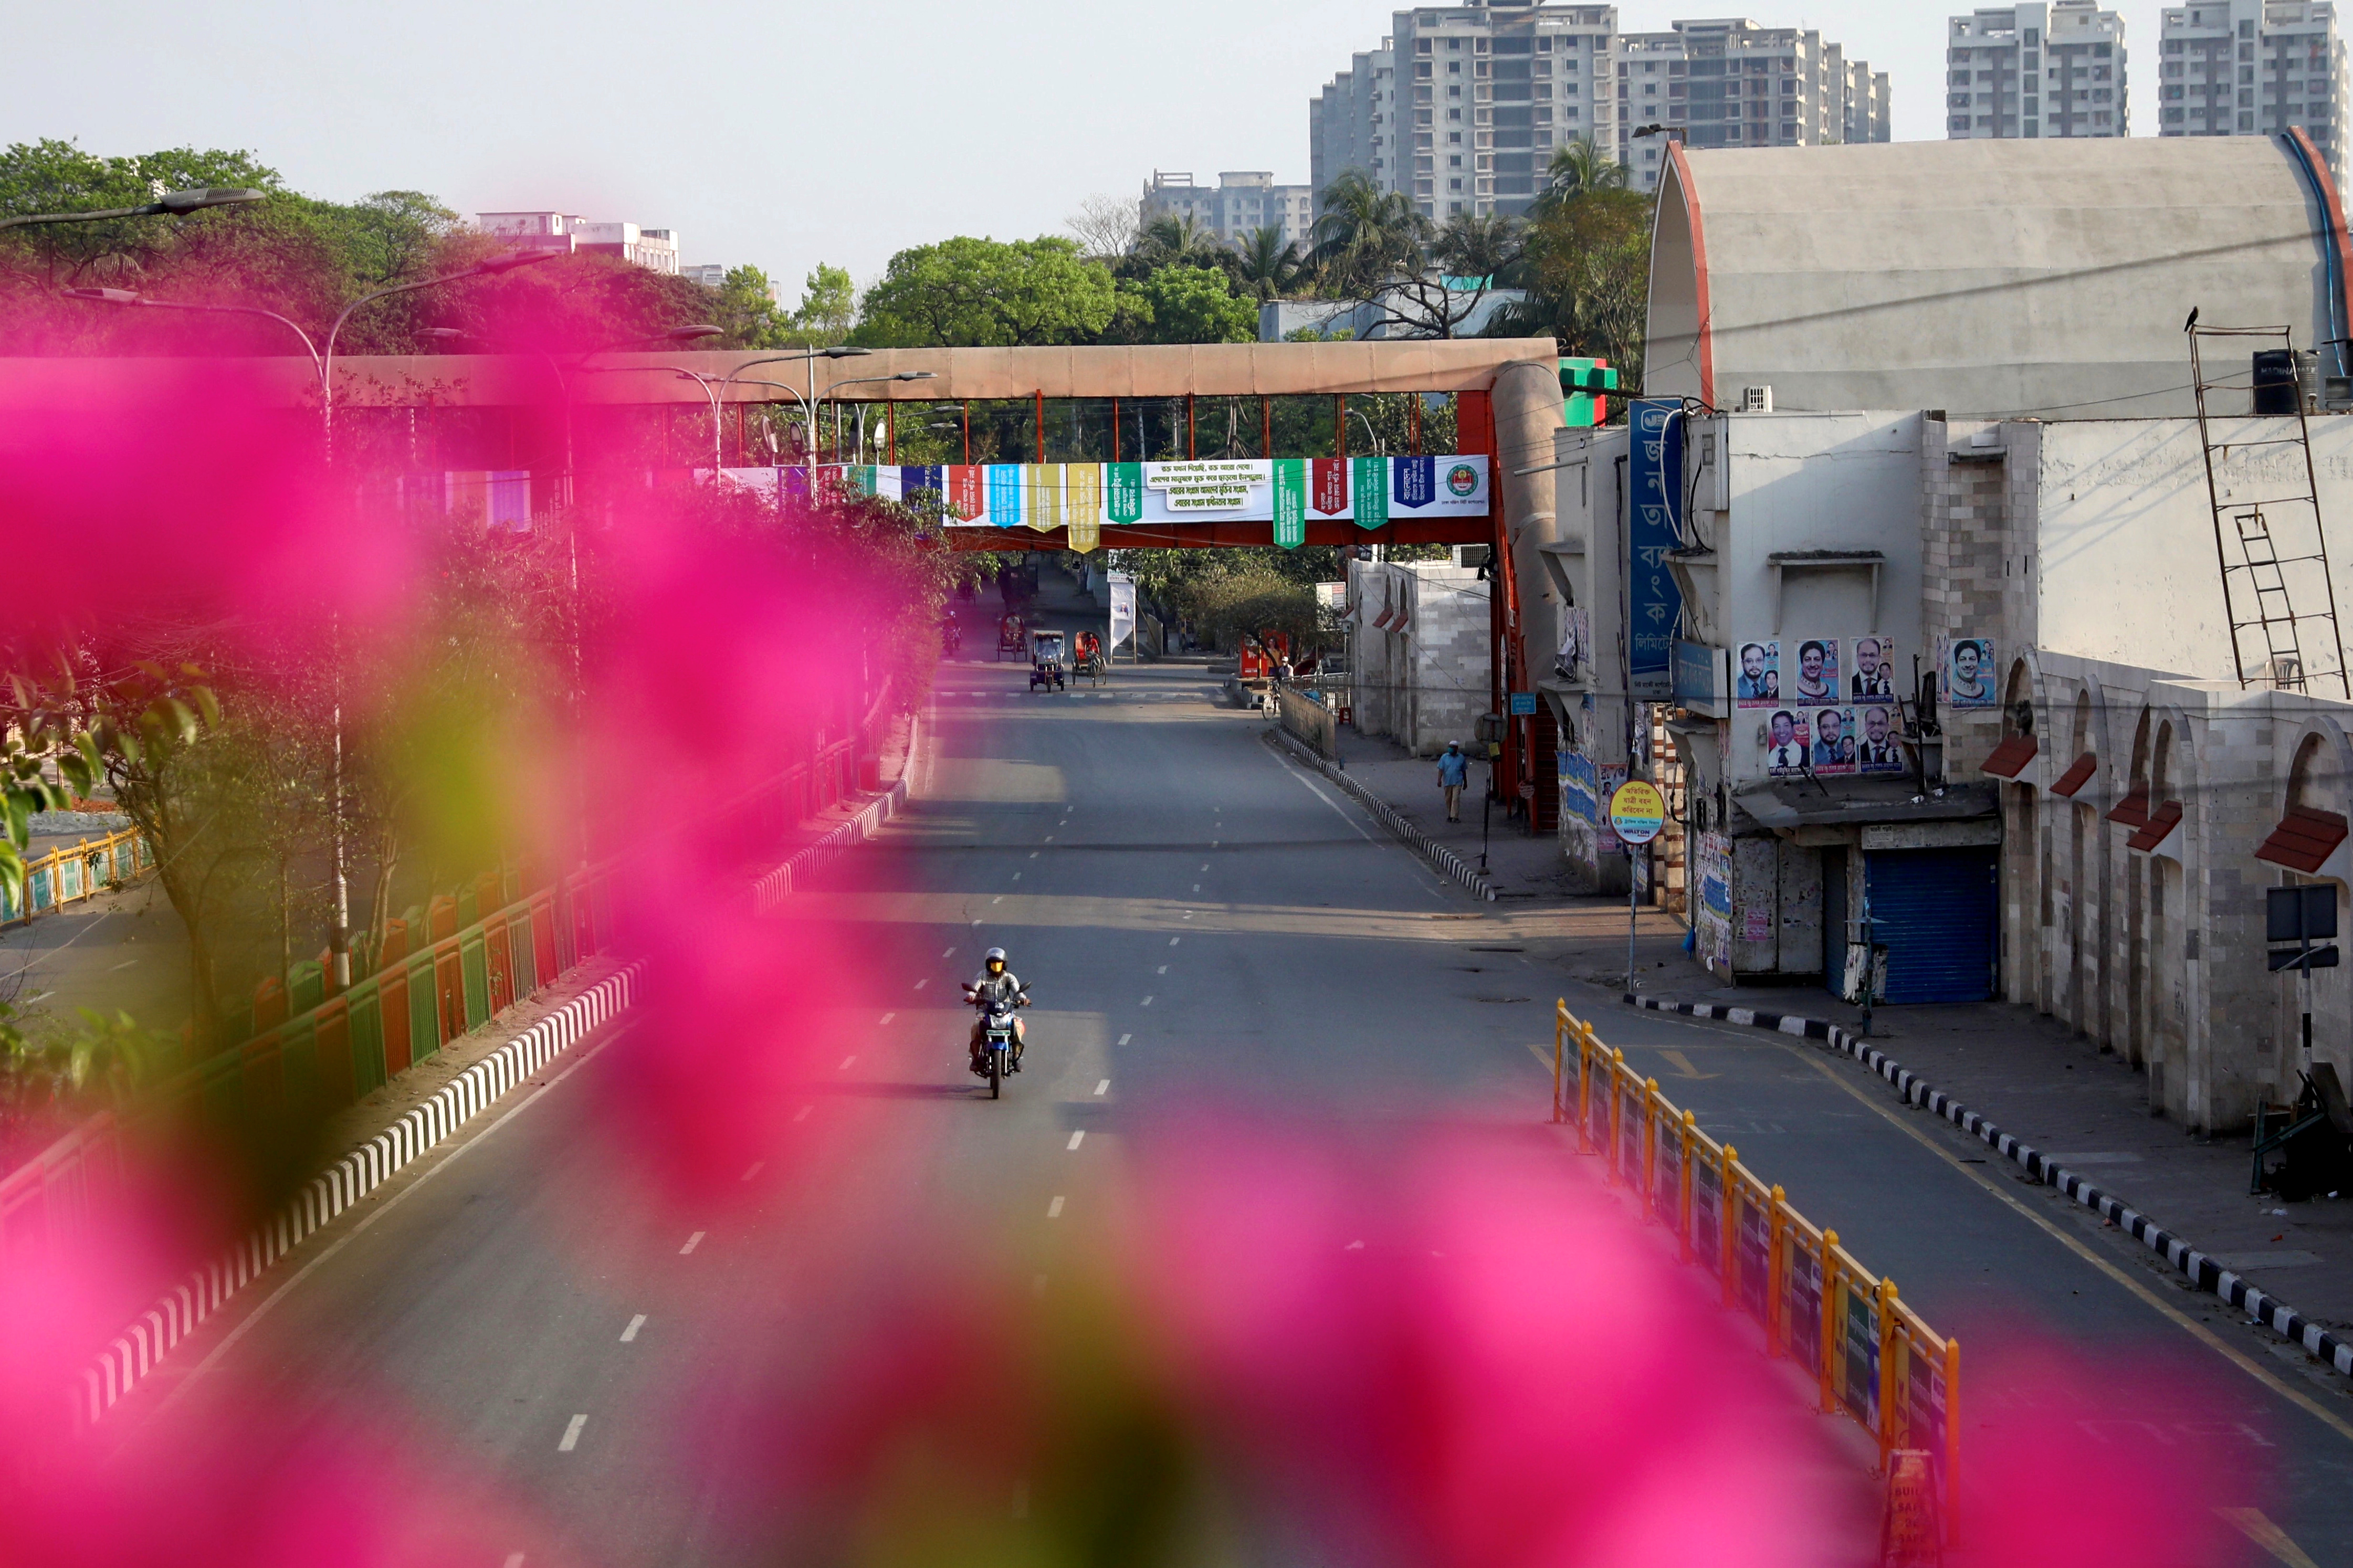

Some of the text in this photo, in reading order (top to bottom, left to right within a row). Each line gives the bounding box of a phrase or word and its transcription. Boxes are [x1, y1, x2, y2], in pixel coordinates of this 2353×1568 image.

[1171, 476, 1192, 484] মানুষকে
[1634, 632, 1672, 651] লিমিটে
[1625, 786, 1650, 795] অতিরিক্ত
